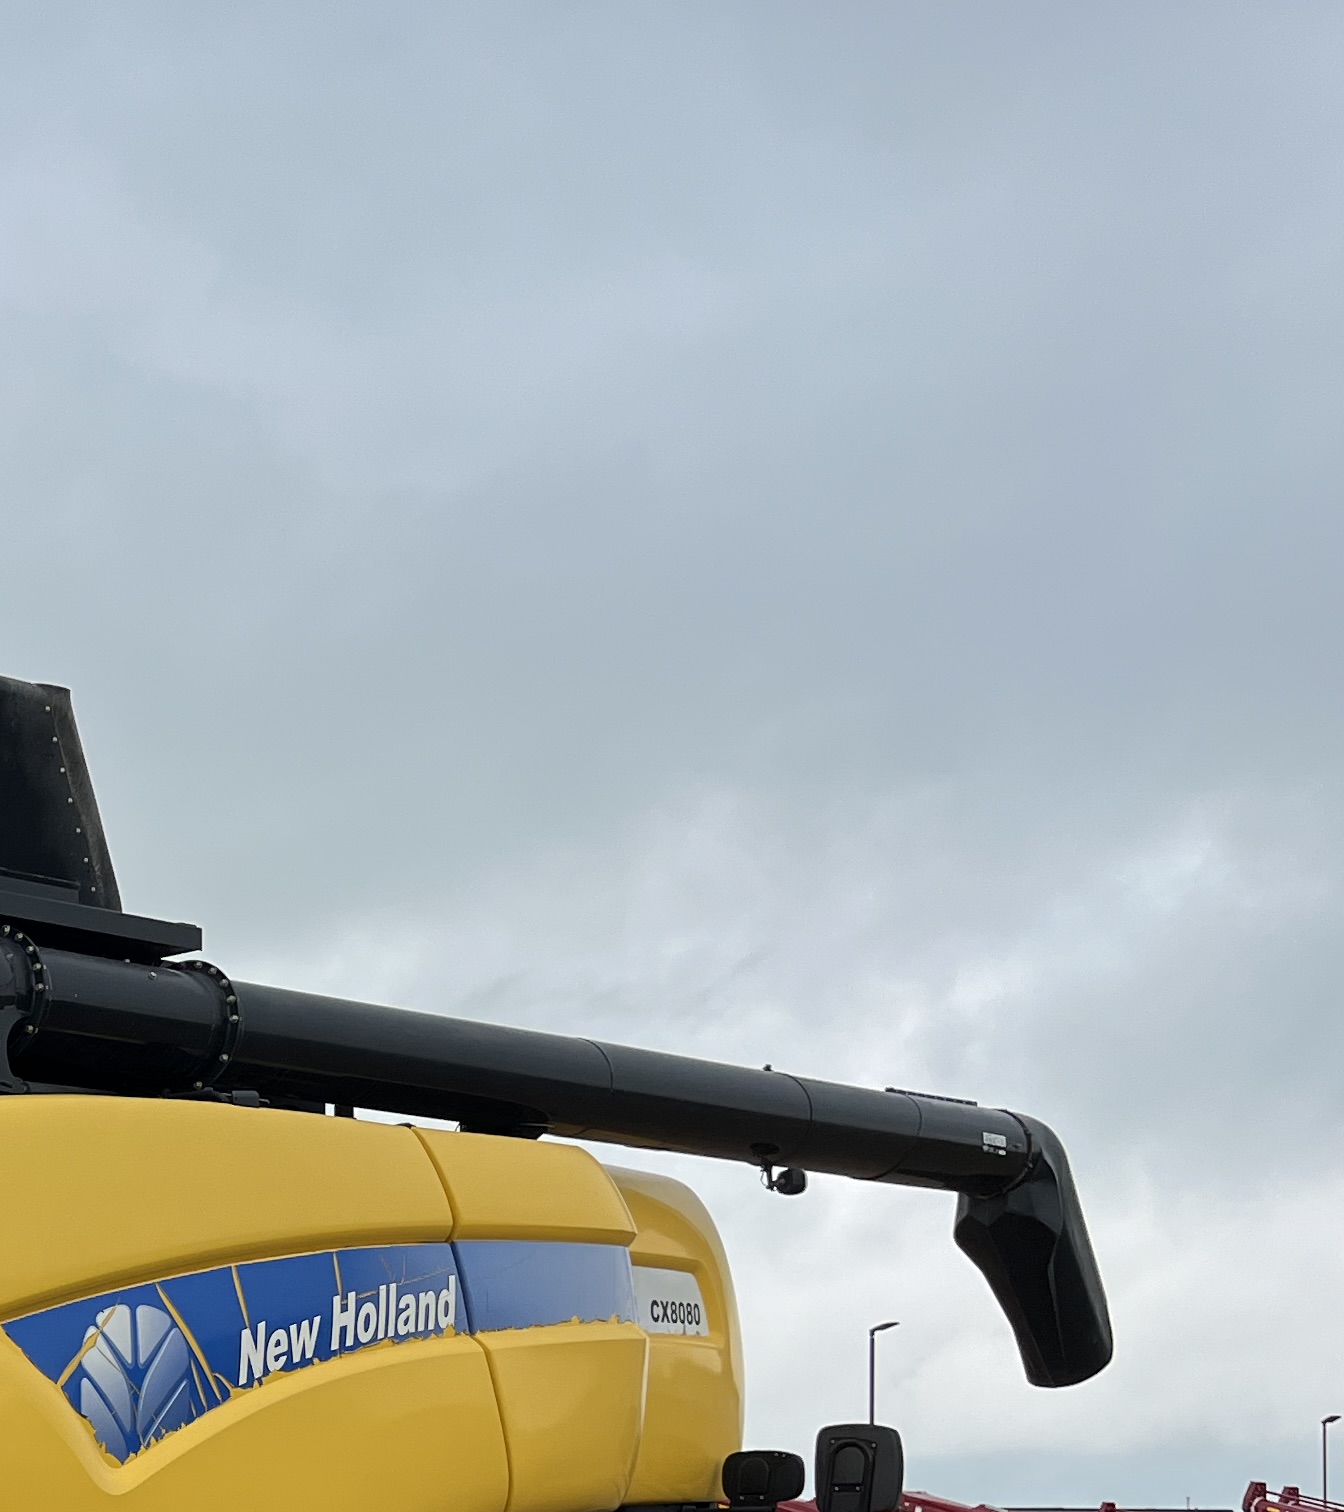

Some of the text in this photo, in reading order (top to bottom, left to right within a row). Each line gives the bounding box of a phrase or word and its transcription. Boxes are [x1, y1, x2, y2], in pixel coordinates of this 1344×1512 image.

[238, 1274, 456, 1386] New Holland
[650, 1299, 701, 1326] CX8080
